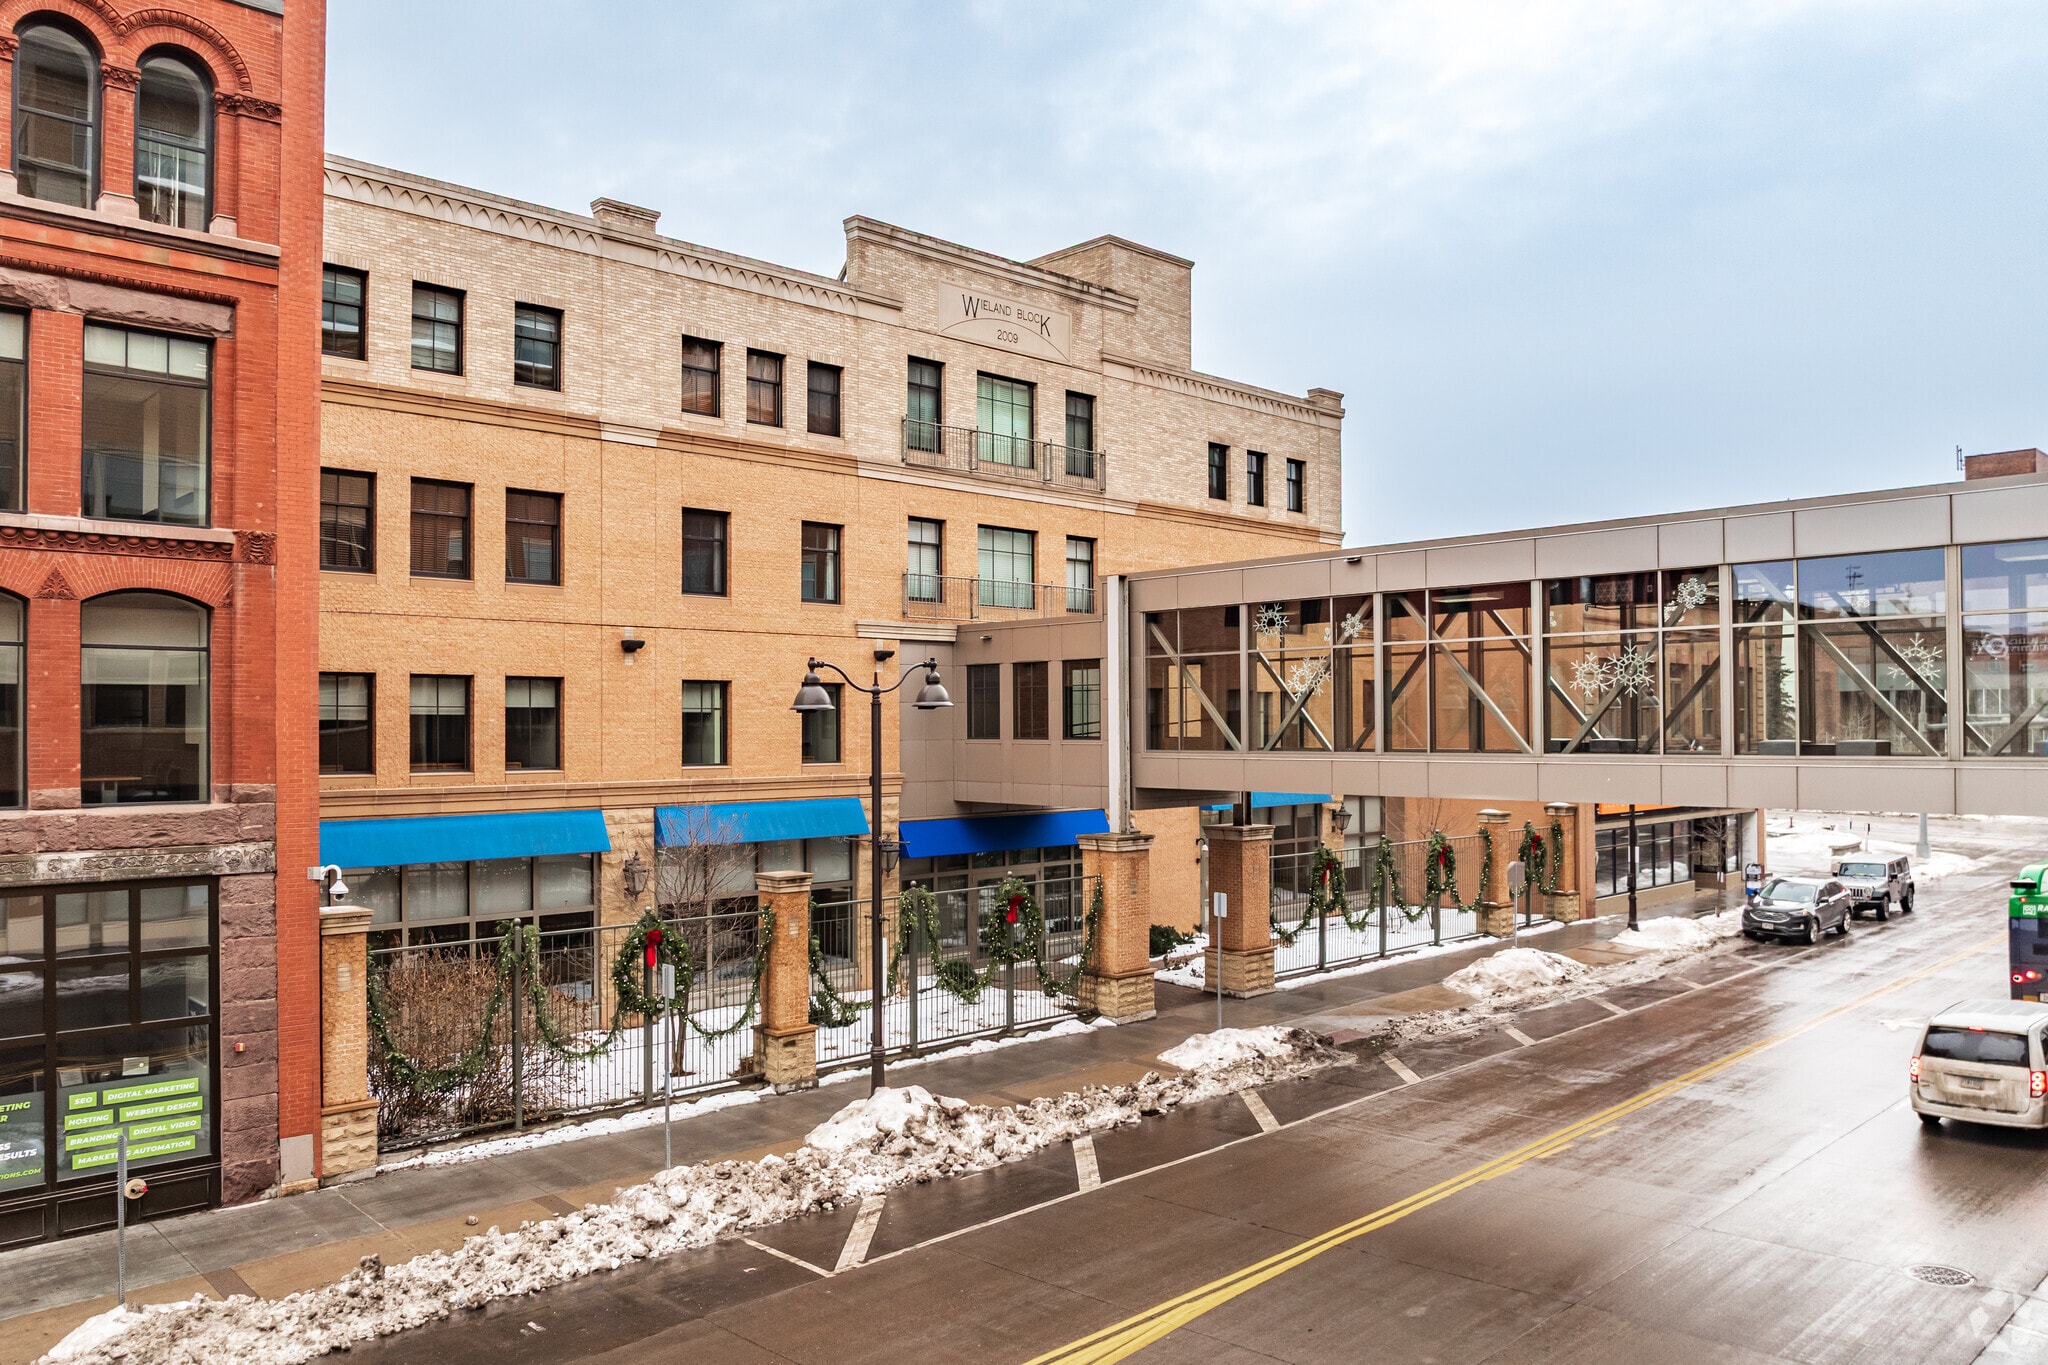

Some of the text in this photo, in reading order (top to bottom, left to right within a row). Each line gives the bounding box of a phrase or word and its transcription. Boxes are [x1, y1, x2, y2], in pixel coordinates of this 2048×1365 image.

[962, 294, 1050, 337] WIELAND BLOCK
[997, 329, 1018, 344] 2009
[107, 1082, 195, 1101] DIGITAL MARKETING
[74, 1096, 93, 1105] SEO
[125, 1100, 198, 1118] WEBSITE DESIGN
[68, 1114, 109, 1126] HOSTING
[133, 1120, 197, 1136] DIGITAL VIDEO
[70, 1132, 119, 1146] BRANDING
[77, 1139, 191, 1165] MARKETIG AUTOMATION
